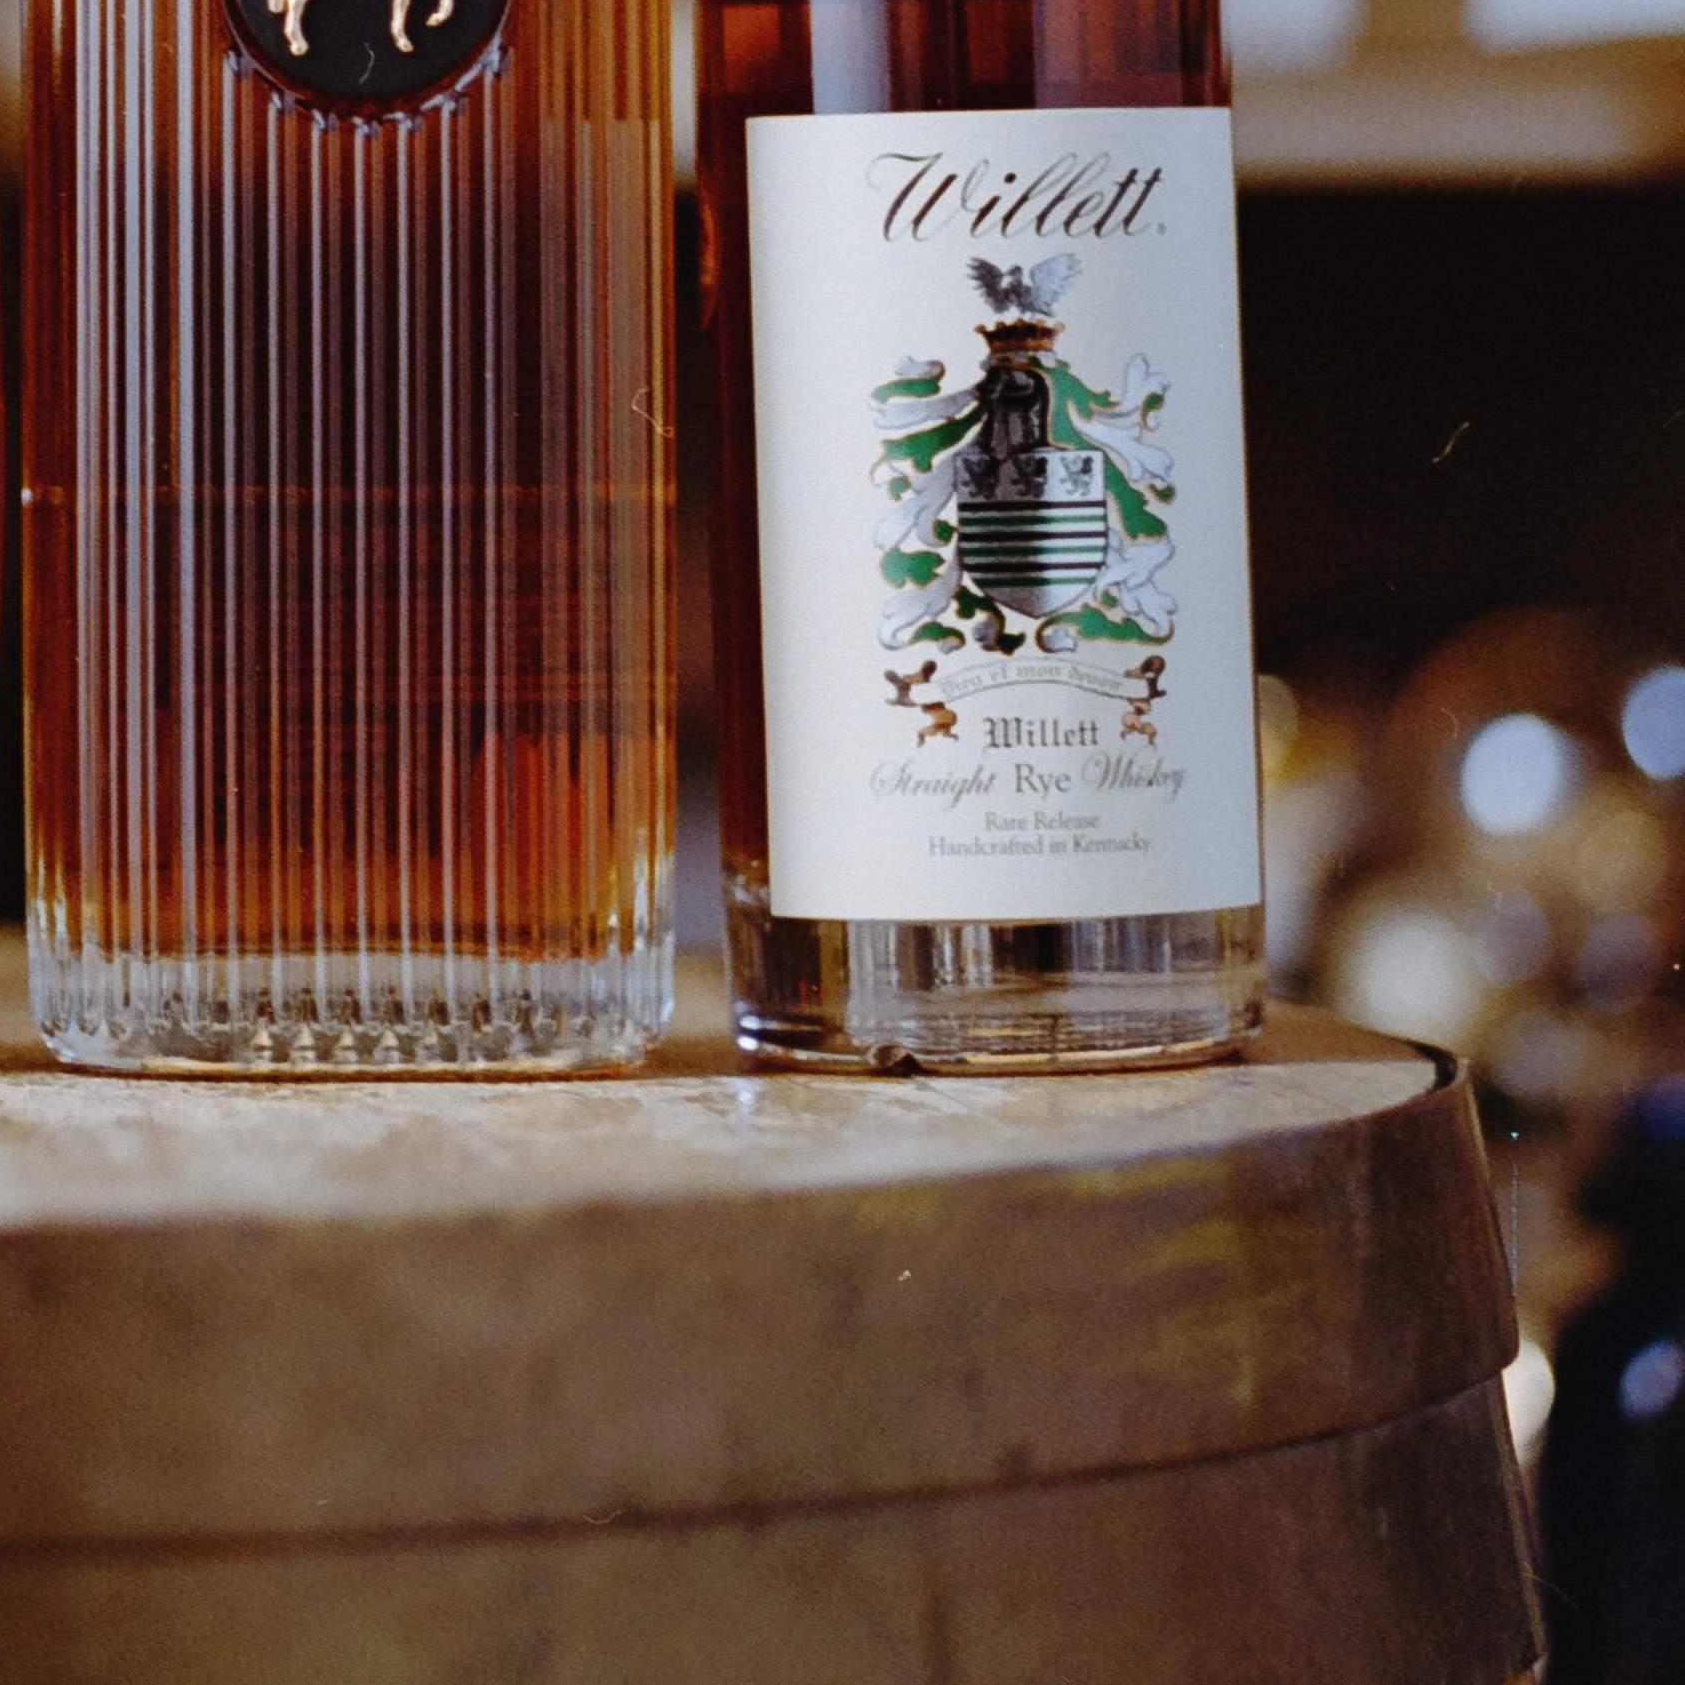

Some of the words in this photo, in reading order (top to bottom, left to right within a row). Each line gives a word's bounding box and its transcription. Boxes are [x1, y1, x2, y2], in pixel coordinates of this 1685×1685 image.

[865, 151, 1160, 242] Willett
[983, 715, 1100, 749] Willett
[870, 756, 998, 815] Straight
[1014, 761, 1072, 801] Rye
[984, 811, 1028, 832] Rare
[1033, 809, 1101, 831] Release
[927, 834, 1045, 858] Handcrafted
[1049, 834, 1068, 856] in
[1071, 832, 1151, 856] Kentucky
